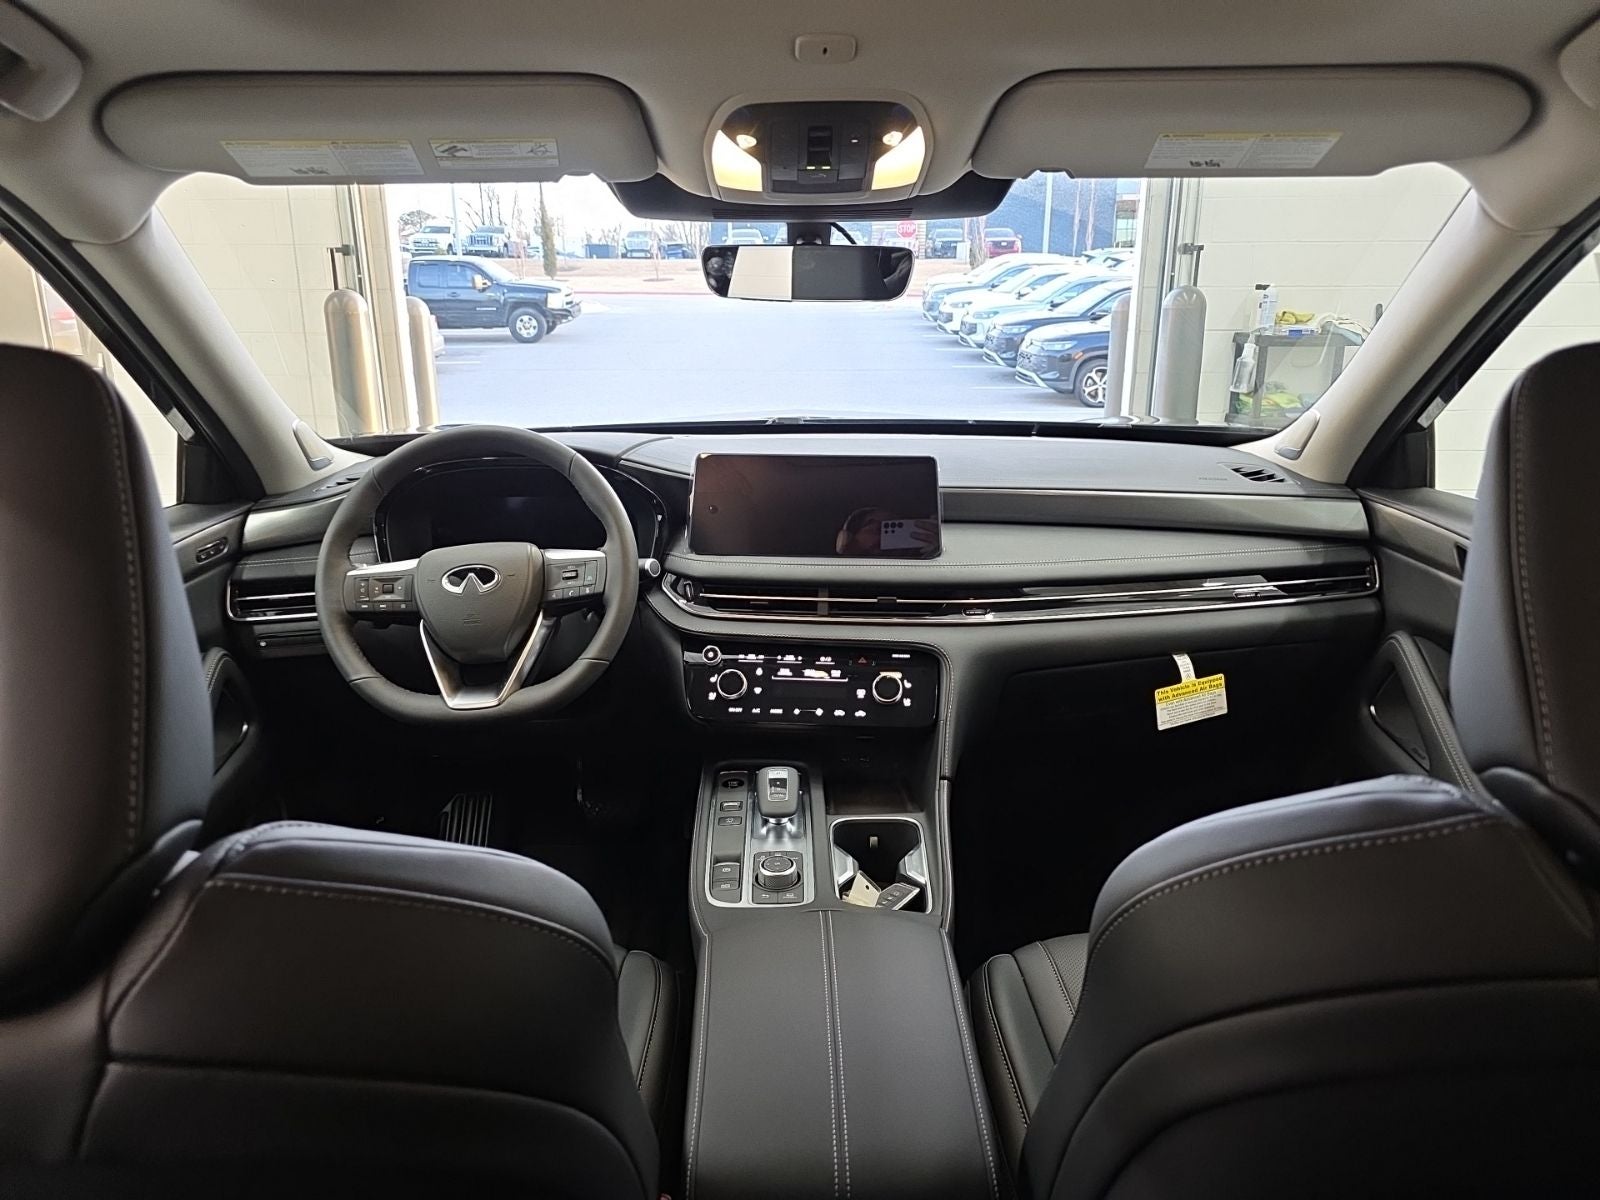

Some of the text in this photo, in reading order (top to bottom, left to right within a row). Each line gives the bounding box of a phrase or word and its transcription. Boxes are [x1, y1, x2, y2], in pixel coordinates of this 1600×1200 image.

[898, 224, 916, 233] STOP
[1170, 684, 1190, 692] Vehicle
[1198, 676, 1222, 686] Equipped
[1172, 688, 1198, 698] Advanced
